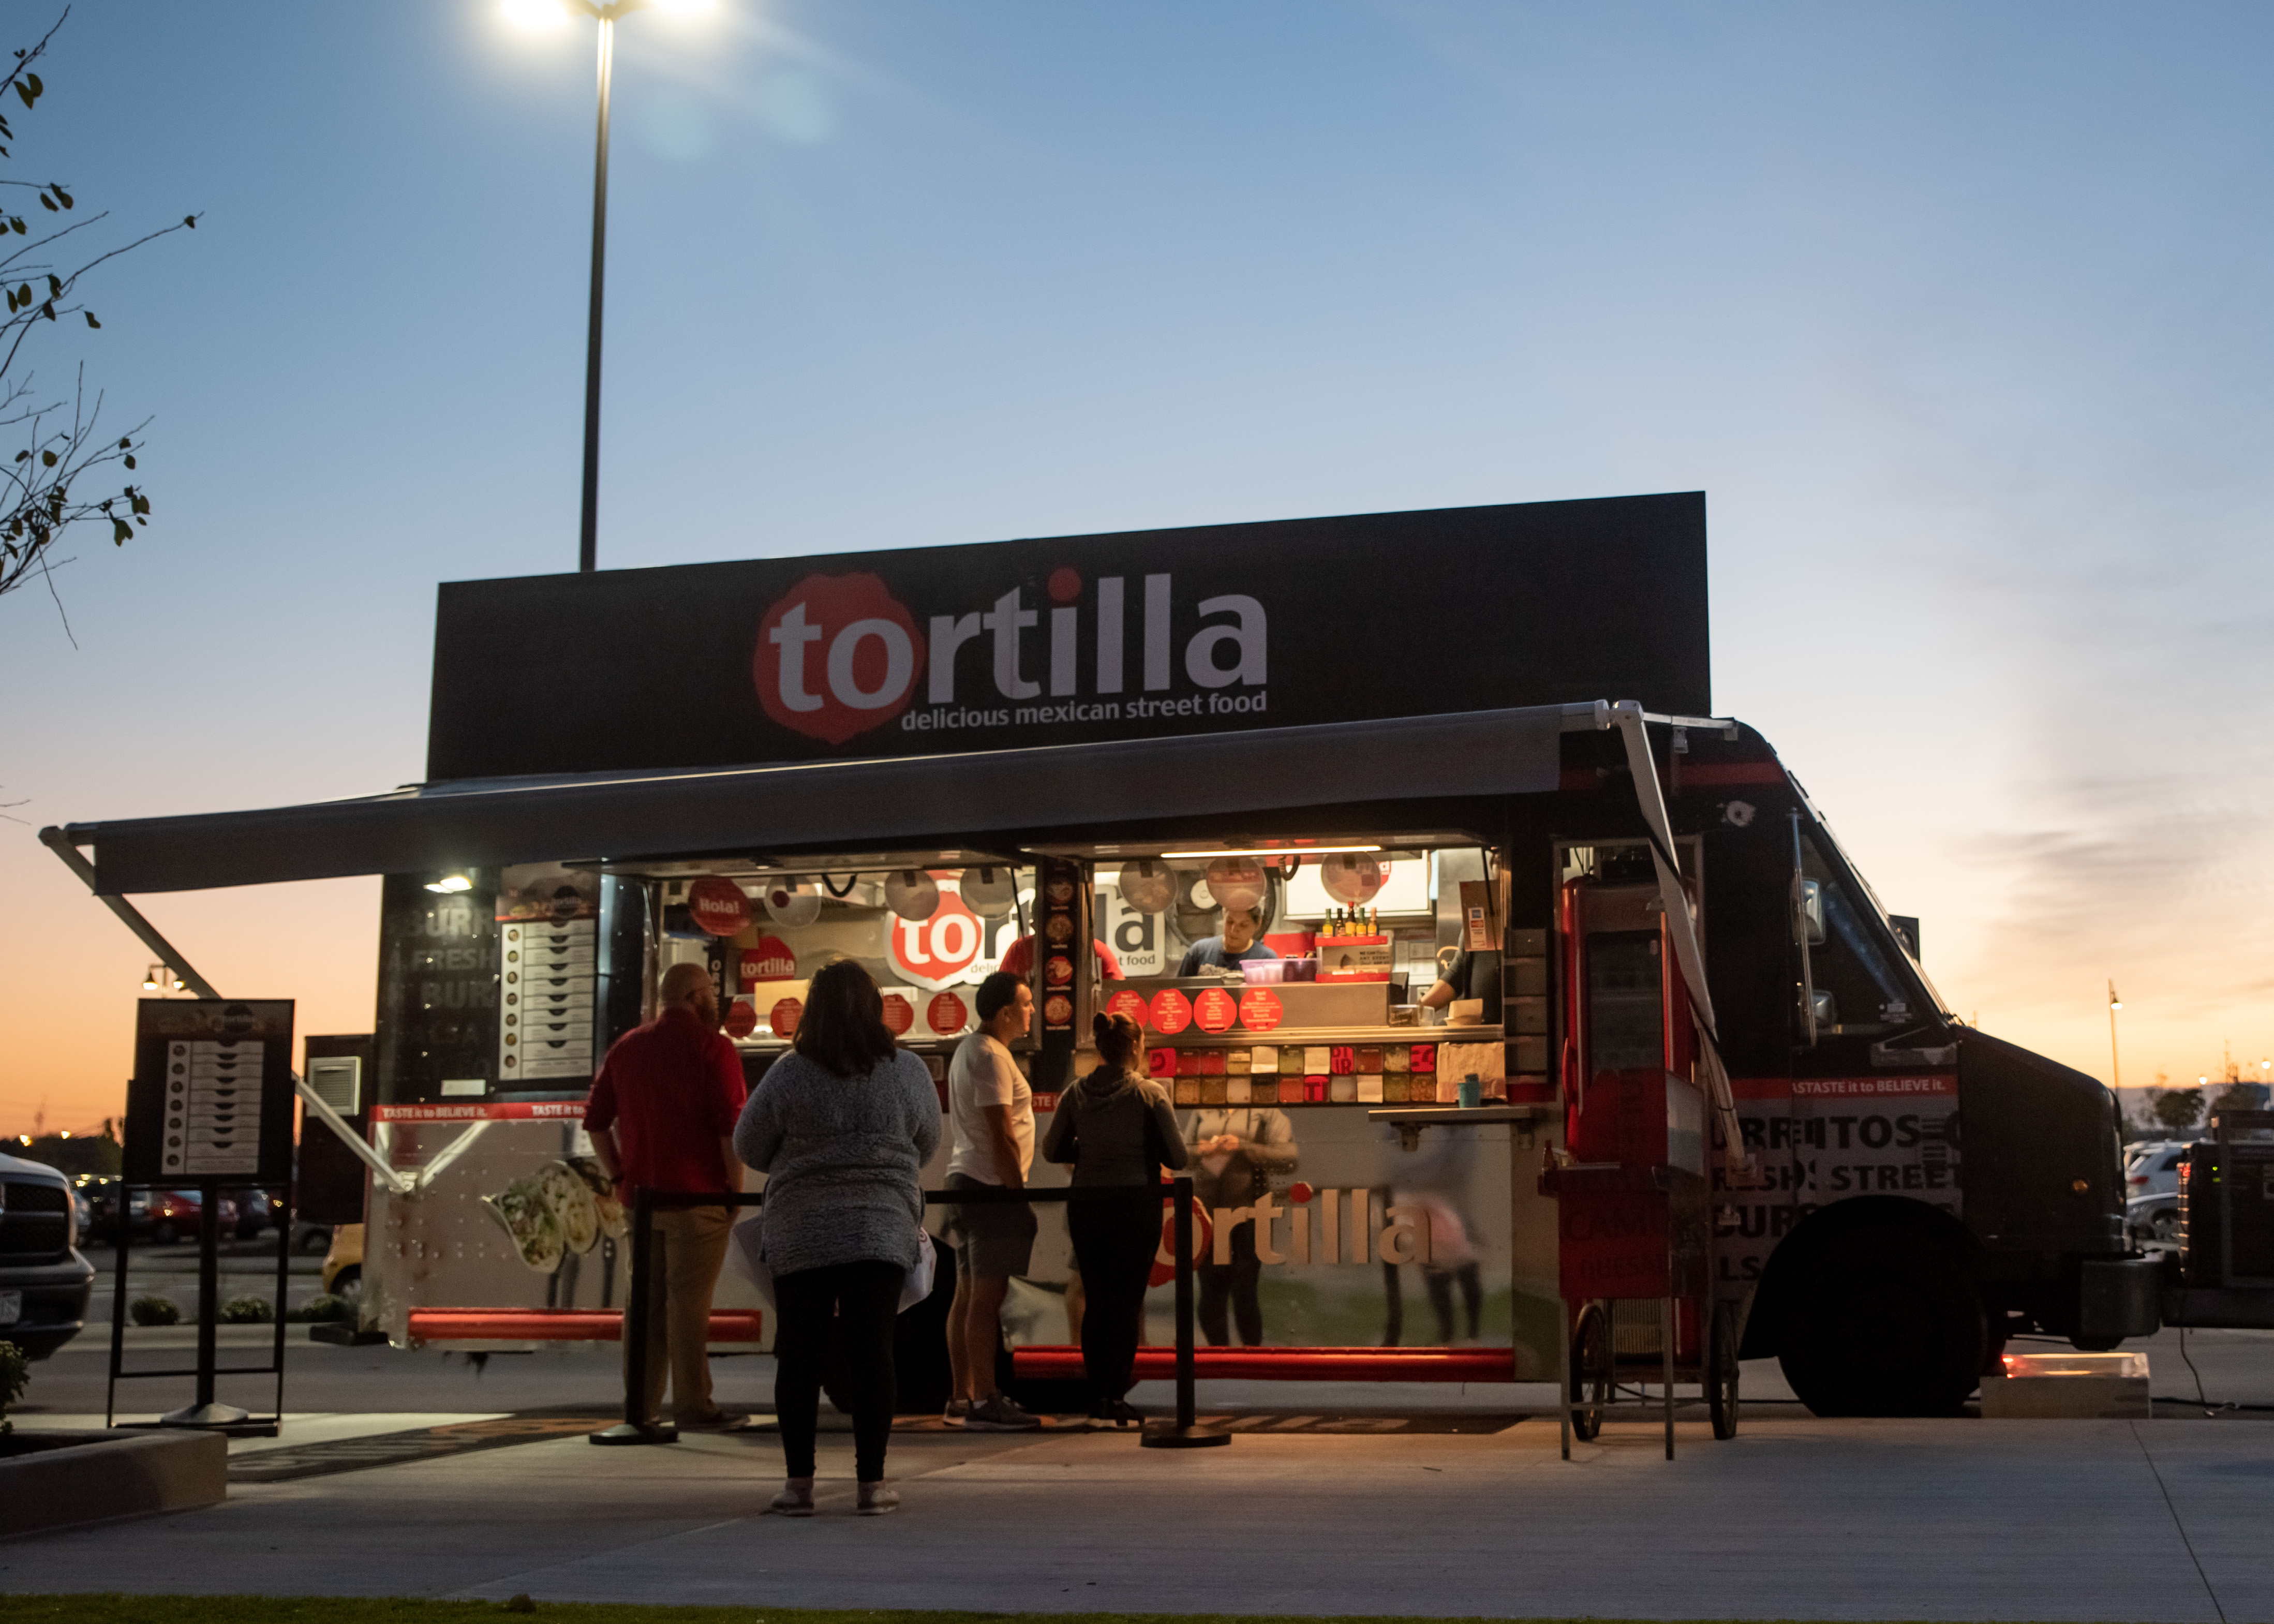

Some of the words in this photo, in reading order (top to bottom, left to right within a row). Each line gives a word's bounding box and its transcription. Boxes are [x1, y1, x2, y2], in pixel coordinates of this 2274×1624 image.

[769, 567, 1267, 712] tortilla
[901, 706, 1009, 731] delicious
[1015, 701, 1119, 725] mexican
[1126, 695, 1203, 719] street
[1209, 691, 1267, 714] food
[700, 898, 740, 914] Hola!
[741, 957, 795, 977] tortilla
[1127, 955, 1155, 965] food
[1848, 1081, 1858, 1092] it
[1860, 1082, 1875, 1092] to
[1877, 1079, 1929, 1092] BELIEVE
[1932, 1079, 1946, 1090] it.
[382, 1108, 413, 1118] TASTE
[414, 1107, 422, 1118] it
[424, 1109, 435, 1118] to
[436, 1107, 475, 1118] BELIEVE
[532, 1105, 562, 1116] TASTE
[563, 1105, 572, 1115] it
[1154, 1181, 1432, 1266] ortilla
